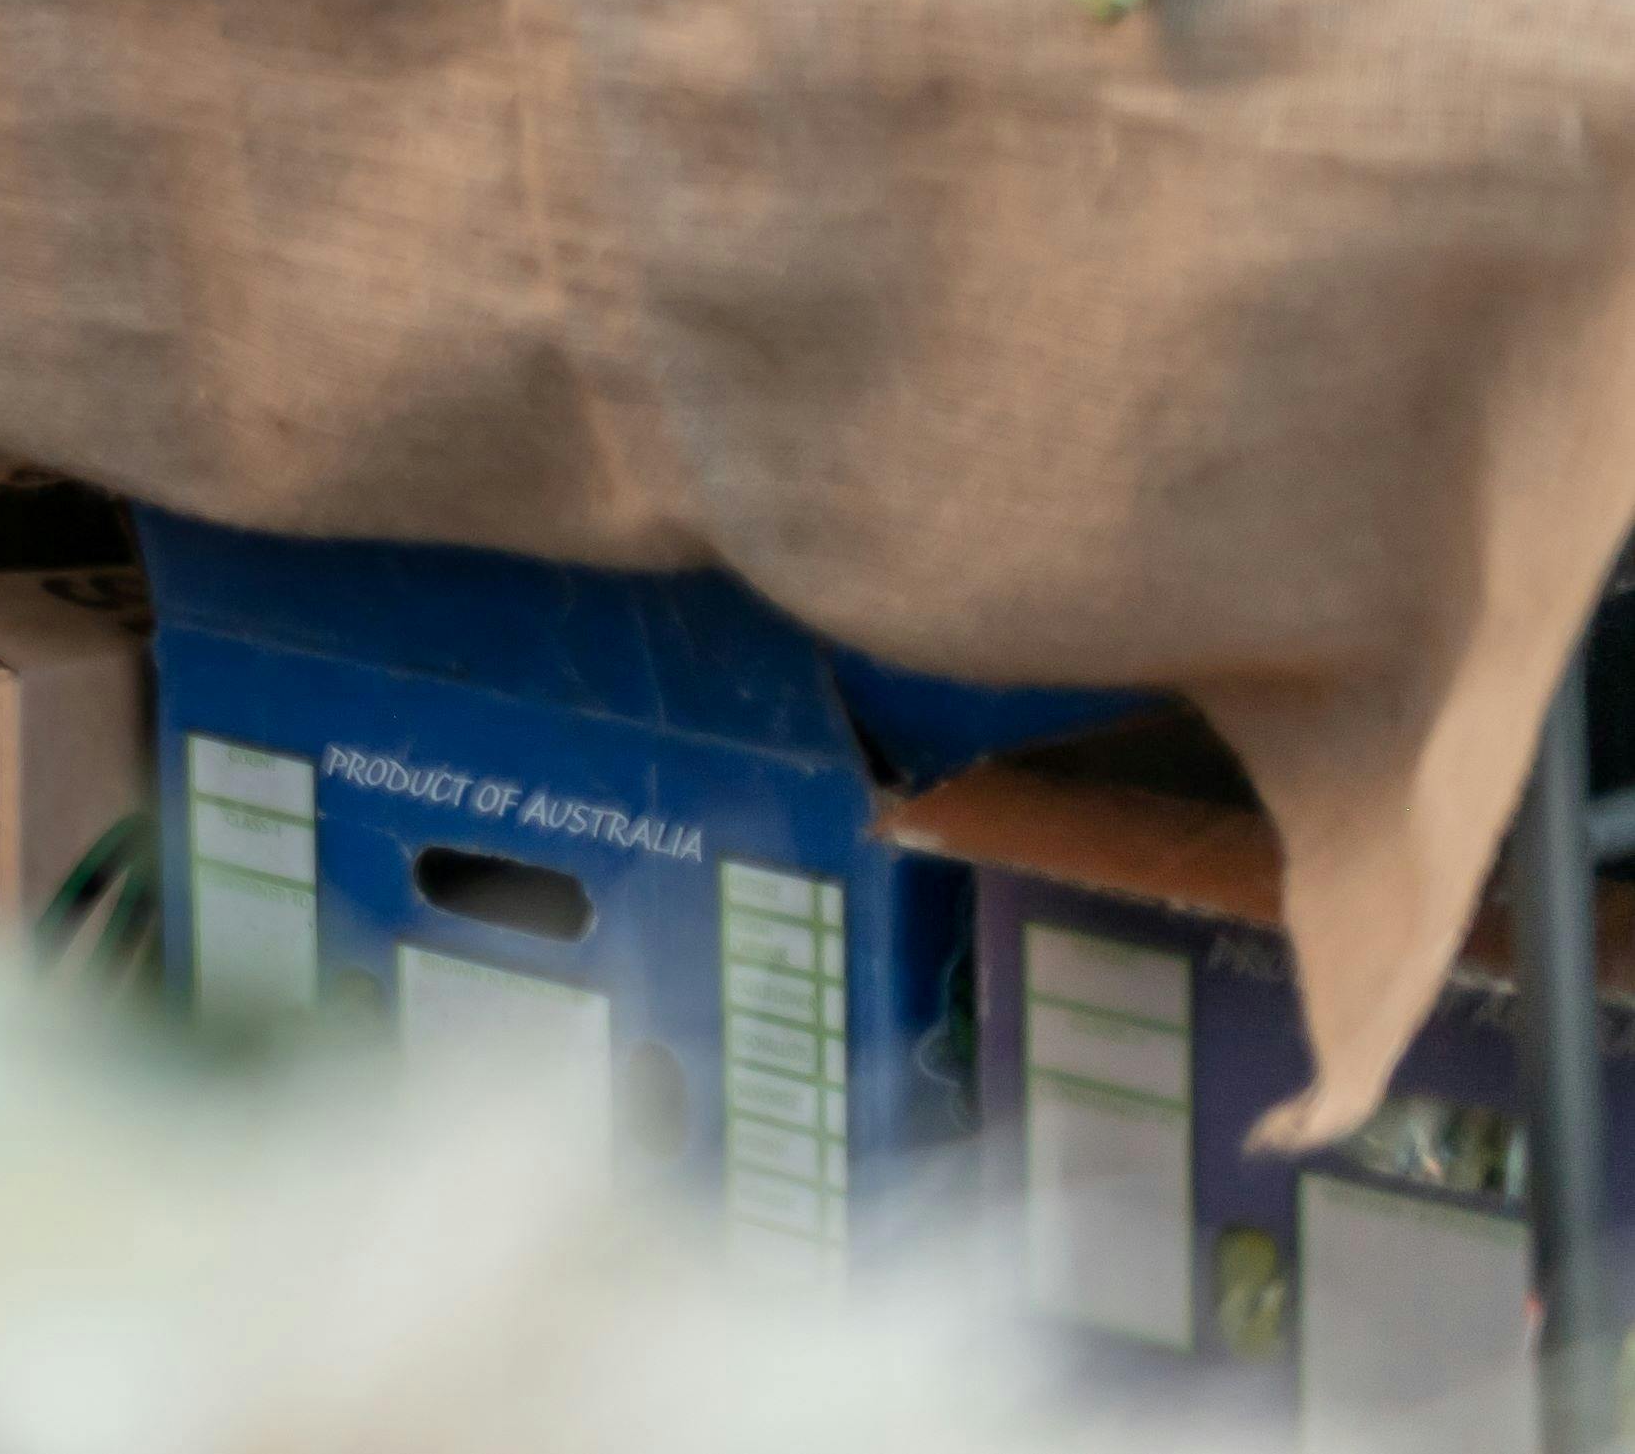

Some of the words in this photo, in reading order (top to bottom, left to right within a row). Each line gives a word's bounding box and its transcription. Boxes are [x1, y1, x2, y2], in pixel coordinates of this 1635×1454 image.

[325, 743, 474, 808] PRODUCT
[476, 783, 522, 818] OF
[521, 794, 704, 864] AUSTRALIA
